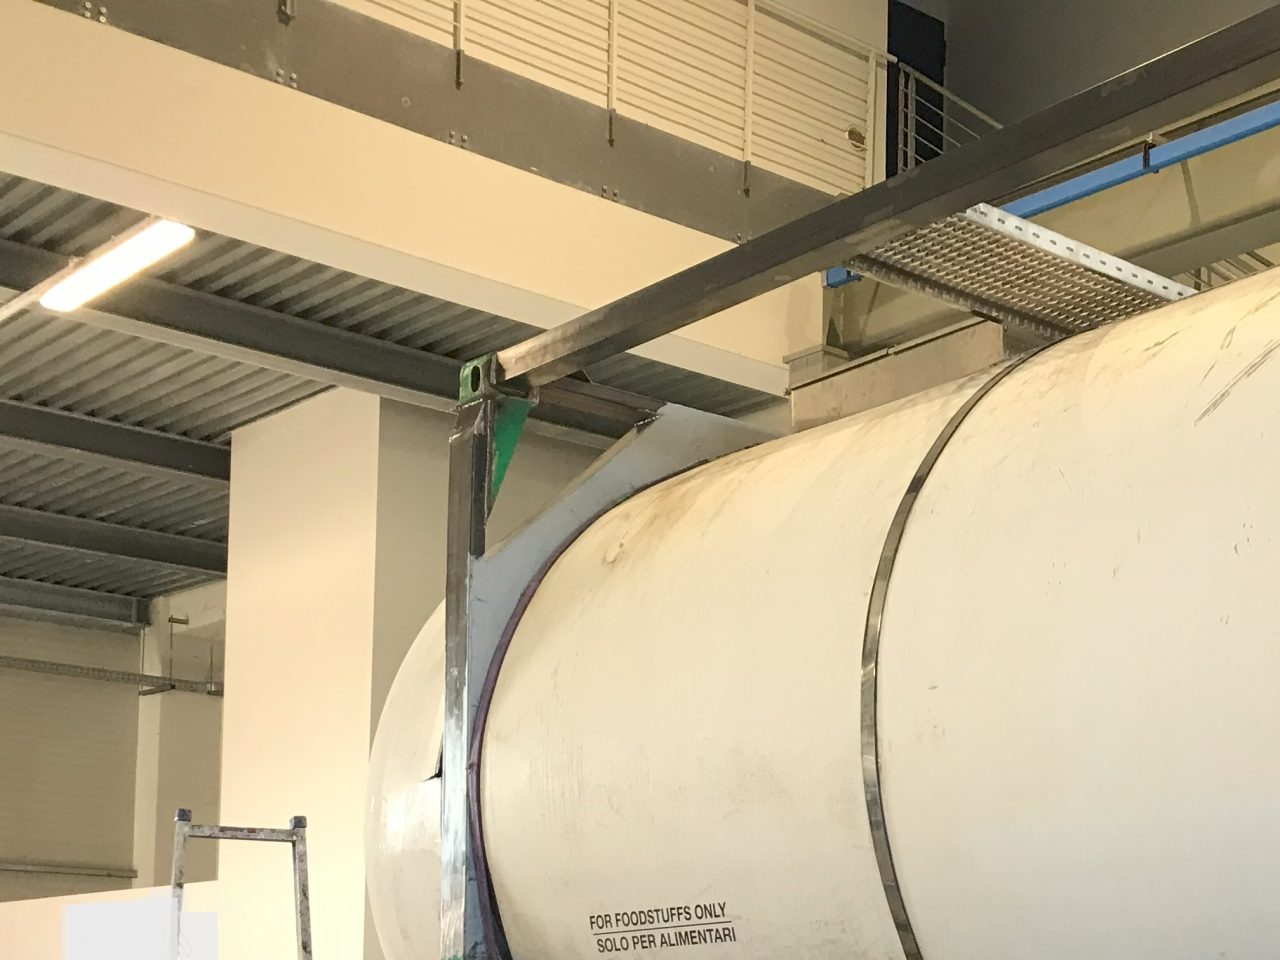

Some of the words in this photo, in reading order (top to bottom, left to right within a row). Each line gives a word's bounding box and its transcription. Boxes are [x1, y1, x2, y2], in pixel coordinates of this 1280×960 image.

[589, 914, 613, 930] FOR
[615, 905, 692, 928] FOODSTUFFS
[694, 902, 727, 920] ONLY
[596, 936, 629, 953] SOLO
[632, 934, 657, 950] PER
[660, 926, 737, 947] ALIMENTARI
